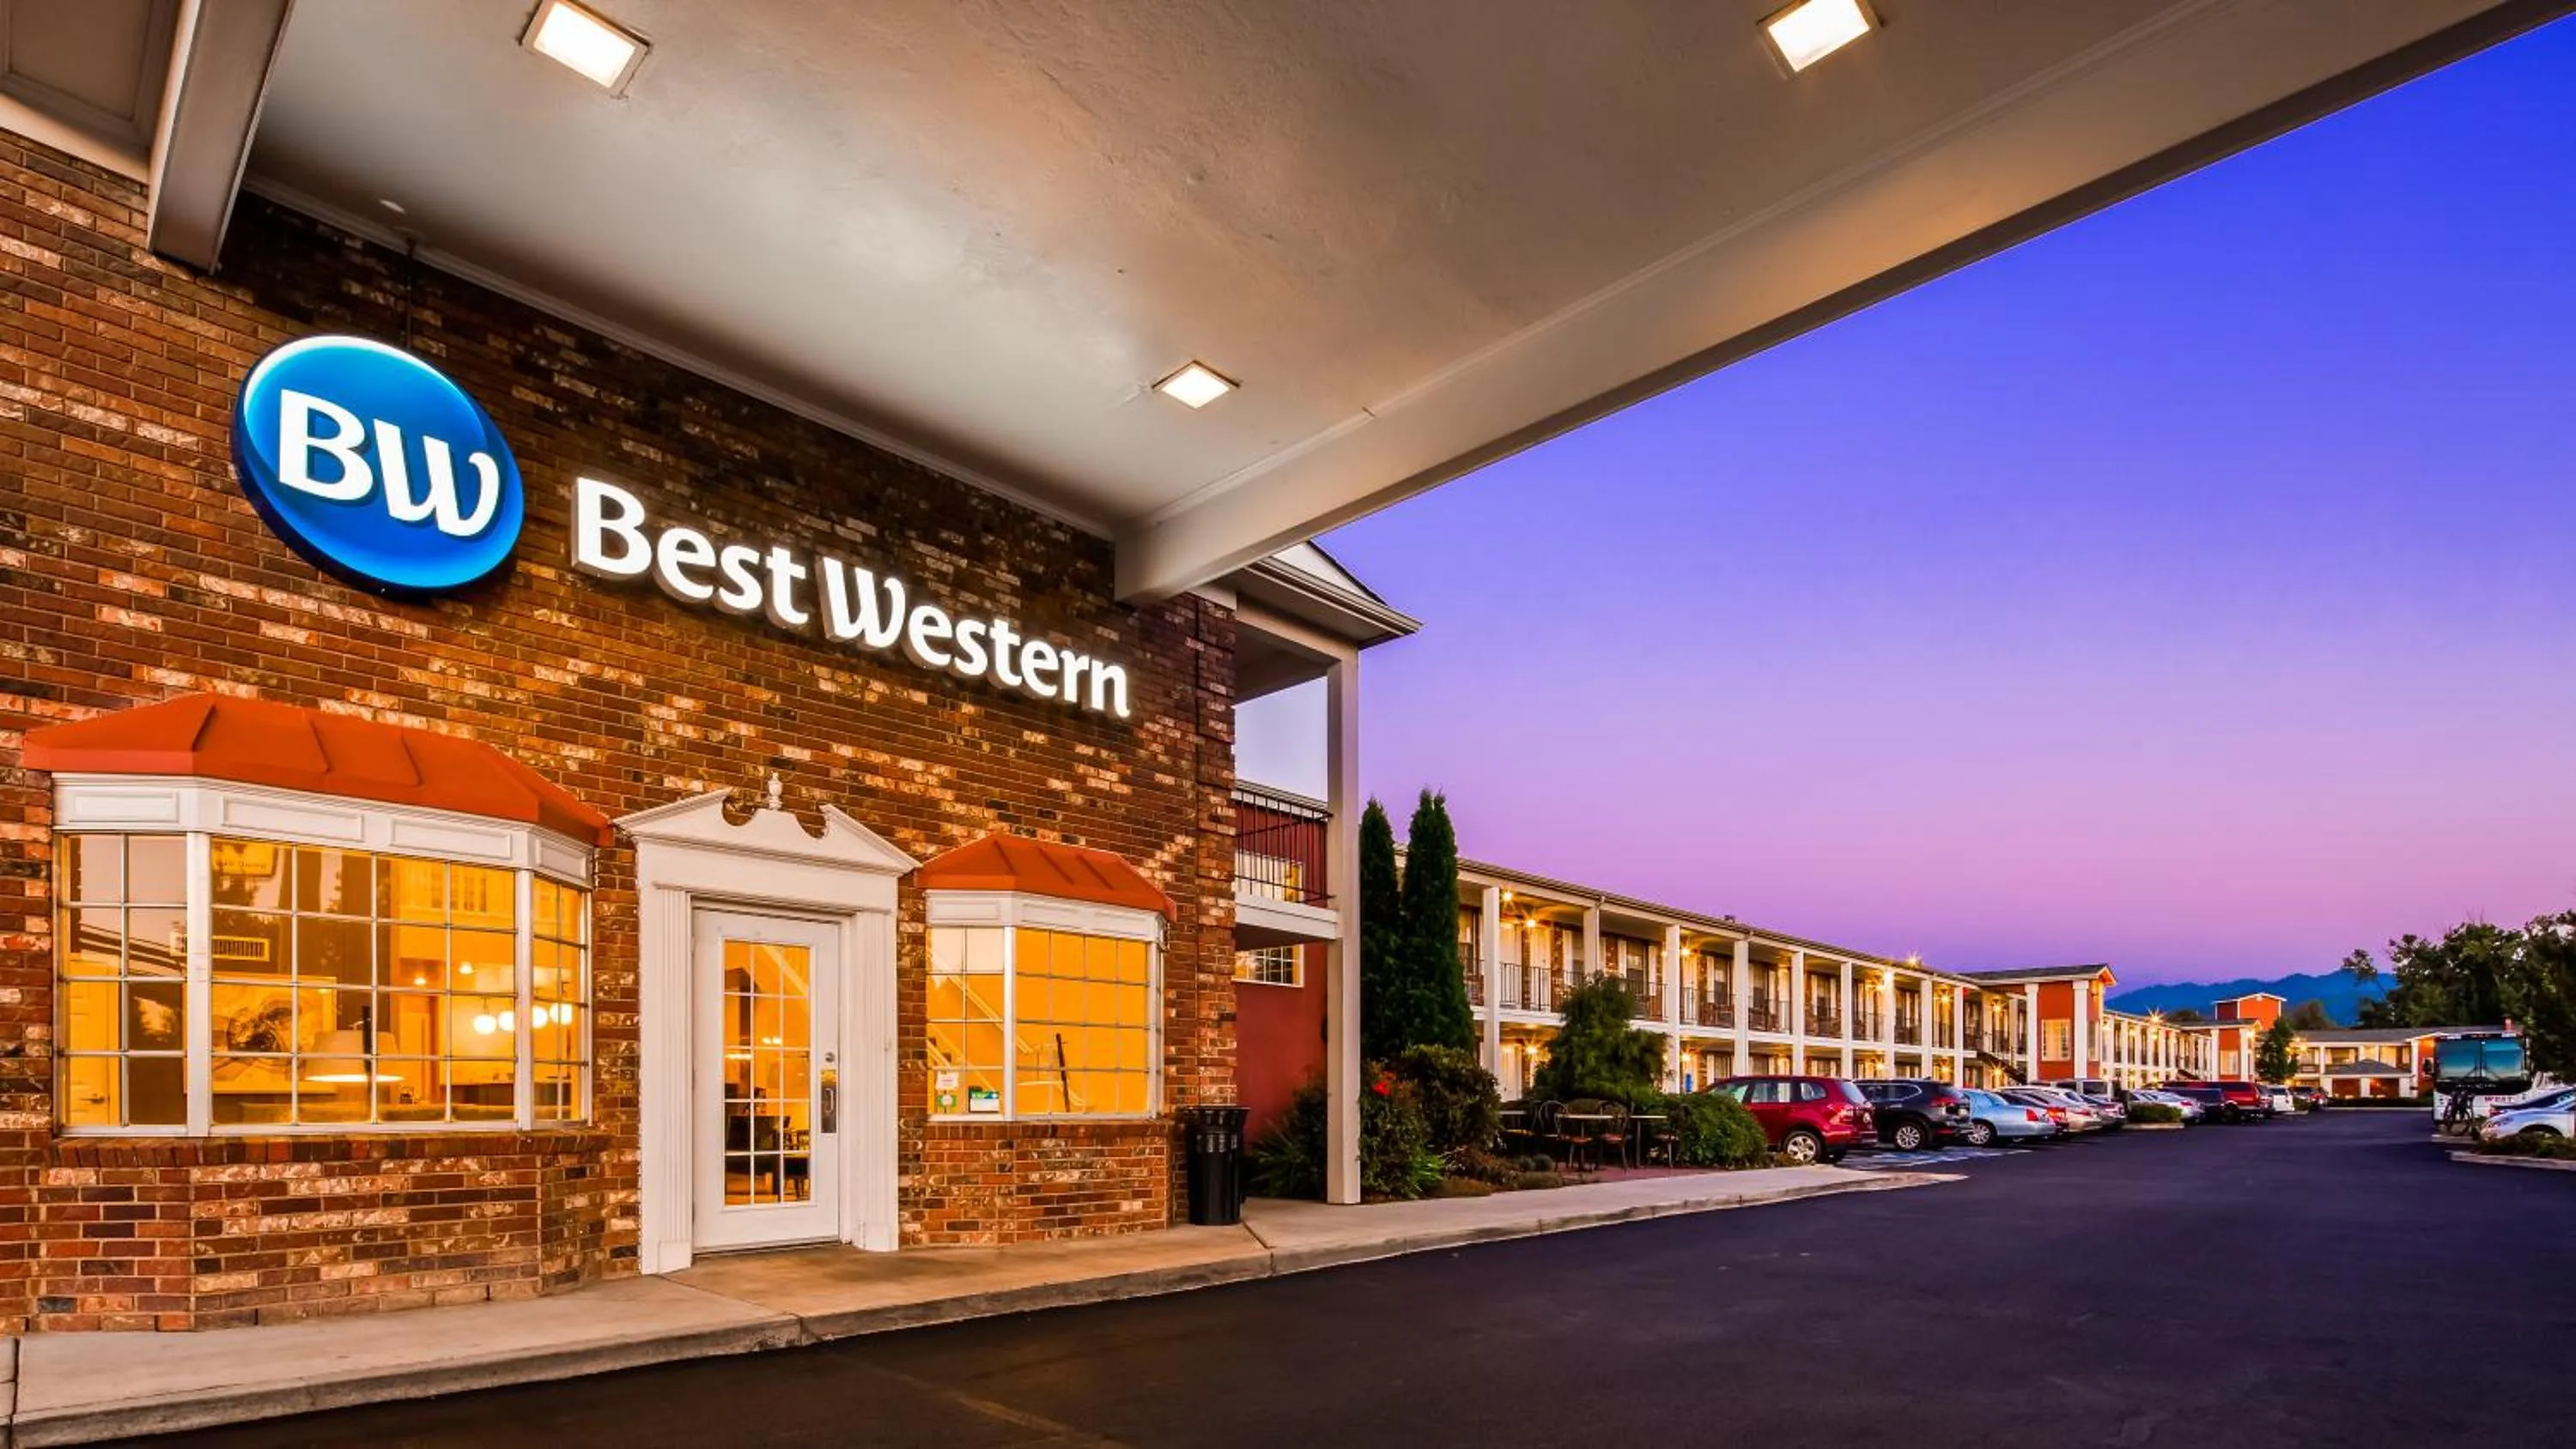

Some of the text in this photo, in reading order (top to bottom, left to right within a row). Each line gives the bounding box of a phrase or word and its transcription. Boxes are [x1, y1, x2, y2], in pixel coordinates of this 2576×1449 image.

[278, 388, 500, 537] BW
[574, 476, 1131, 718] Best Western
